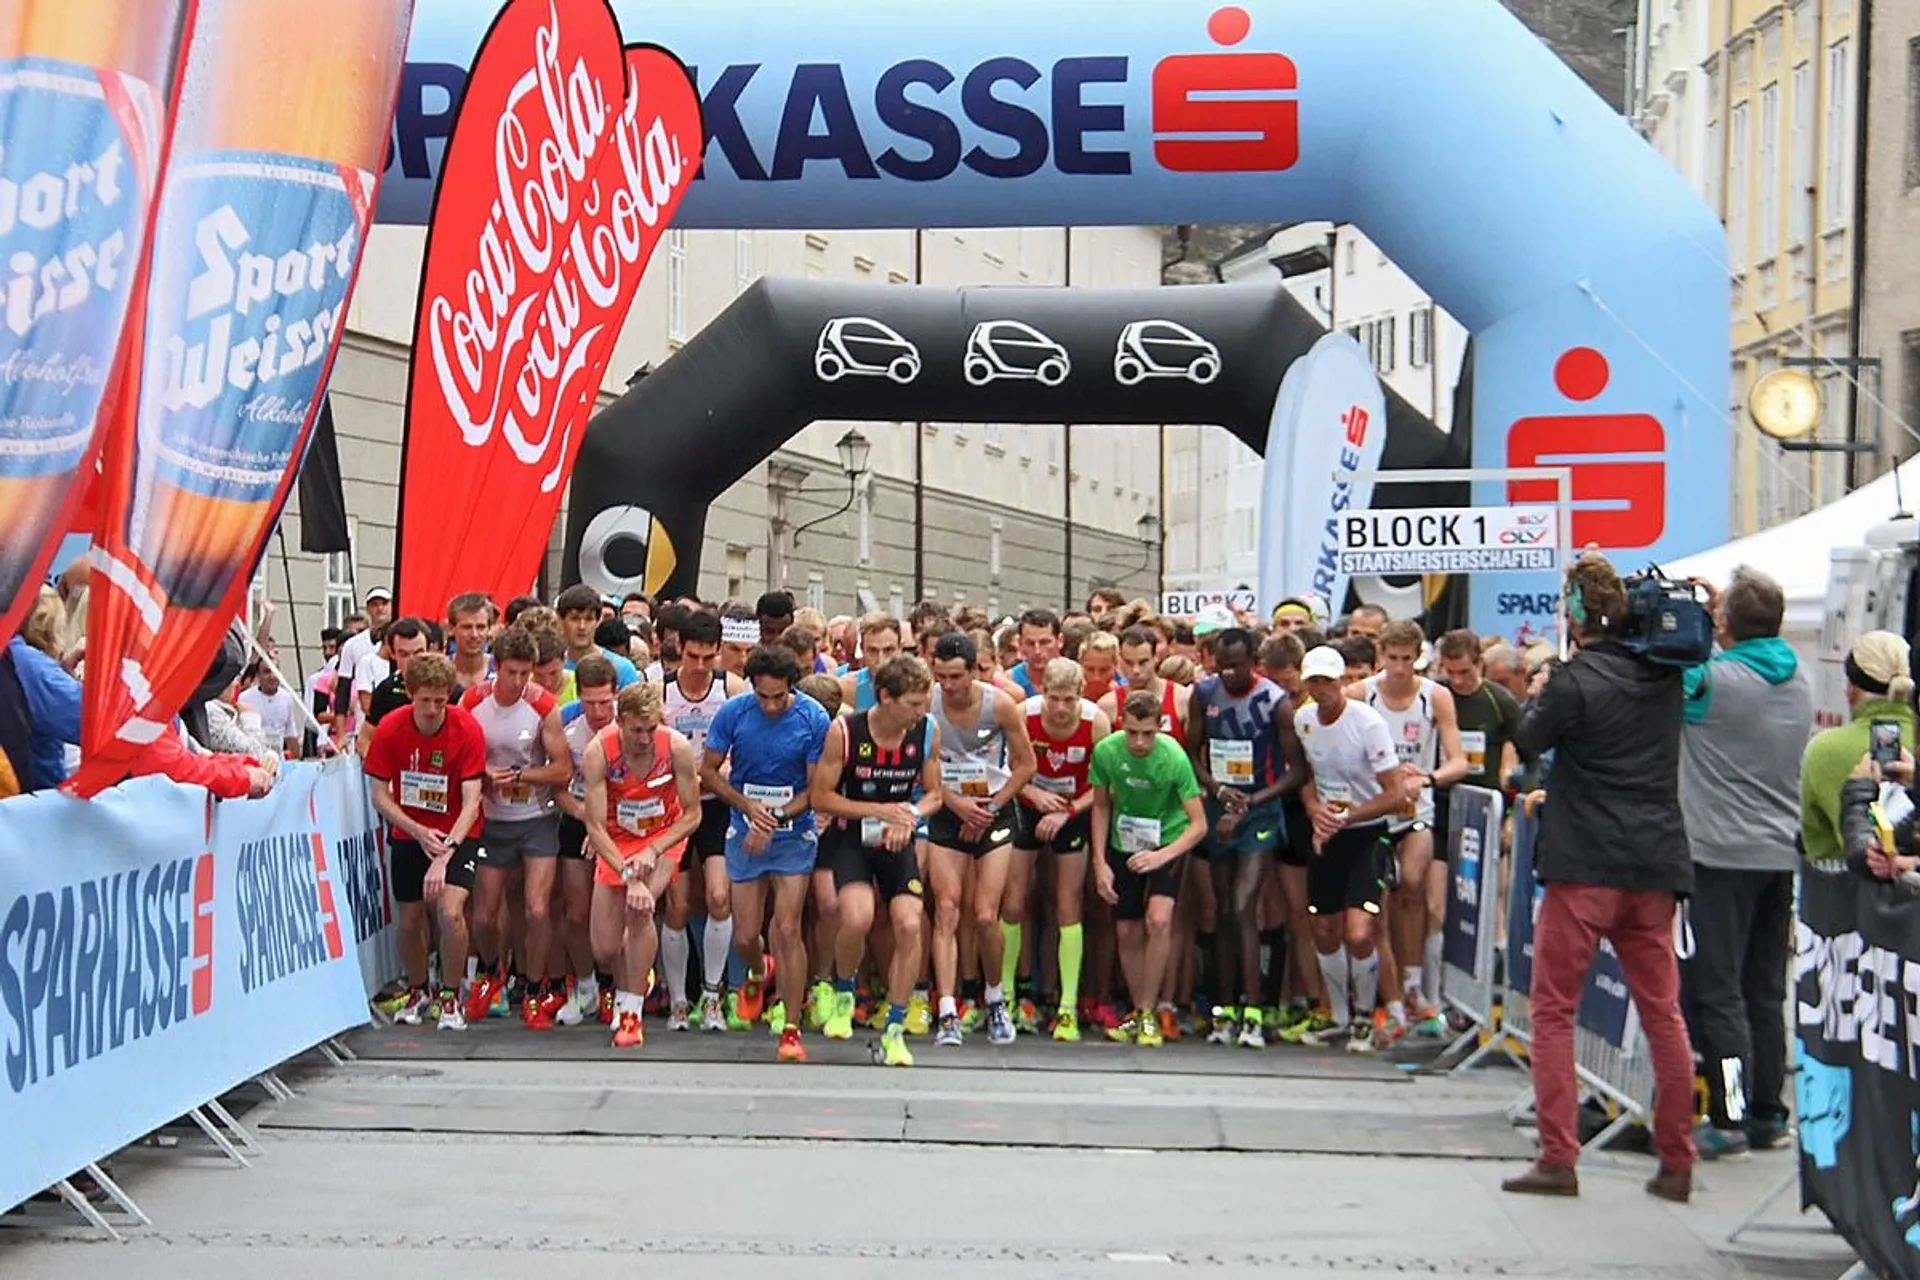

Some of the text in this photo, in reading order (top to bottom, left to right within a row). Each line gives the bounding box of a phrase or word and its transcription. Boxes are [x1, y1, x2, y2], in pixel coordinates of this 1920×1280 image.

[186, 204, 355, 321] Sport
[430, 0, 609, 447] Coca-Cola
[1343, 549, 1550, 572] STAATSMEISTERSCHAFTEN
[1346, 515, 1486, 547] BLOCK 1
[1244, 594, 1256, 612] 2
[236, 832, 328, 995] SPARKASSE
[2, 857, 193, 1093] SPARKASSE
